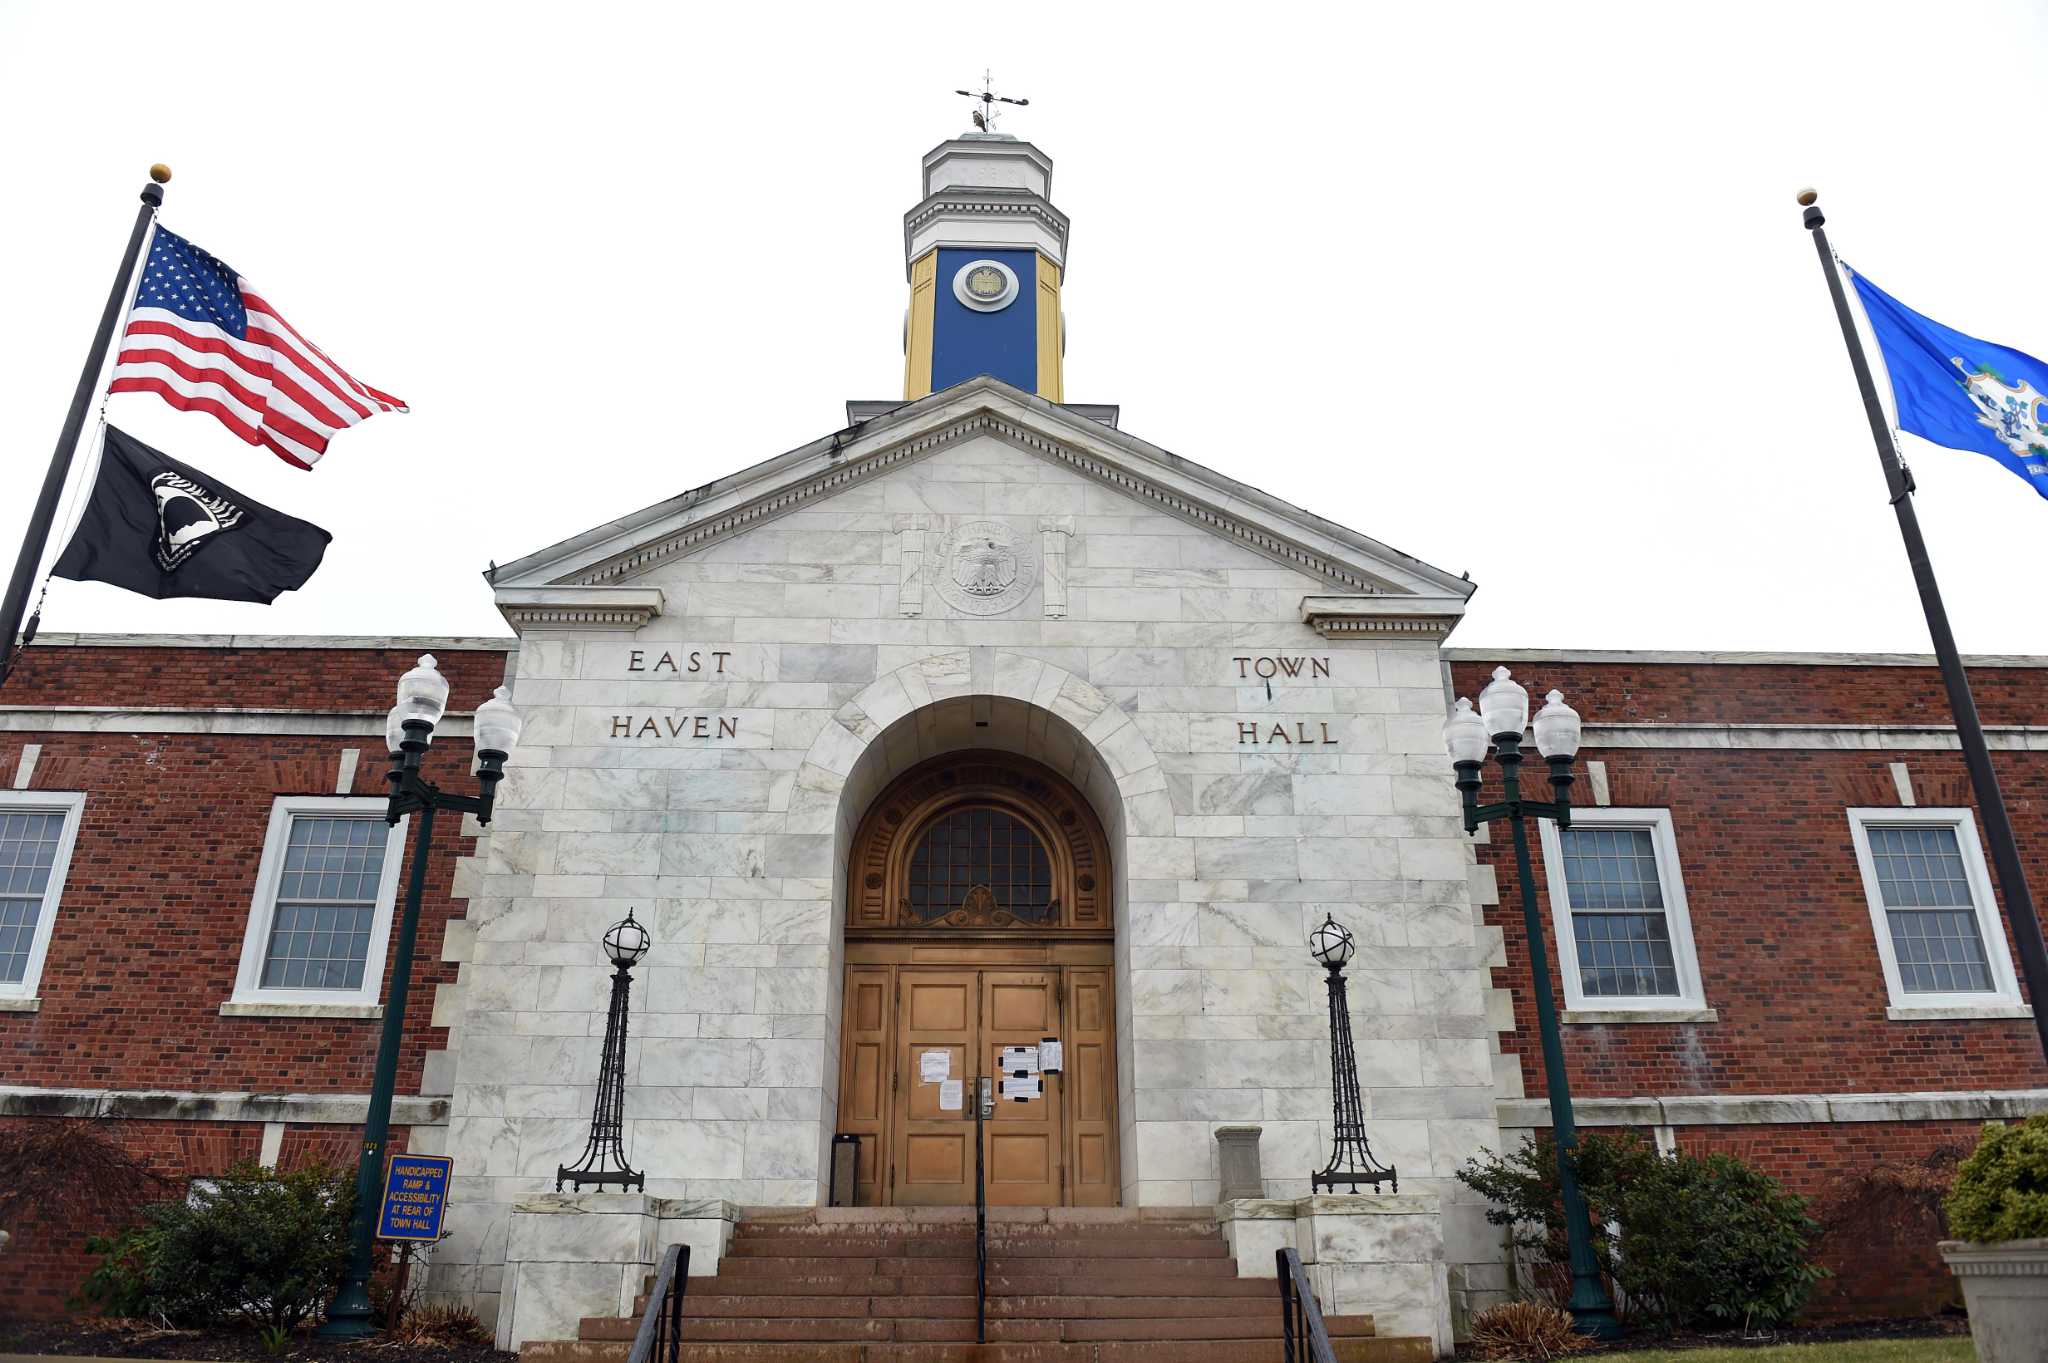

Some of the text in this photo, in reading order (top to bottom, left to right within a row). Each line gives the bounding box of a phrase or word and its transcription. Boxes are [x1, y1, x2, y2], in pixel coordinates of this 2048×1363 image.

[627, 650, 731, 673] EAST
[1232, 657, 1330, 678] TOWN
[610, 715, 739, 739] HAVEN
[1237, 722, 1339, 744] HALL
[395, 1165, 444, 1178] HANDICAPPED
[402, 1179, 431, 1190] RAMP &
[389, 1192, 441, 1204] ACCESSIBILITY
[392, 1205, 434, 1216] AT REAR OF
[390, 1217, 431, 1229] TOWN HALL
